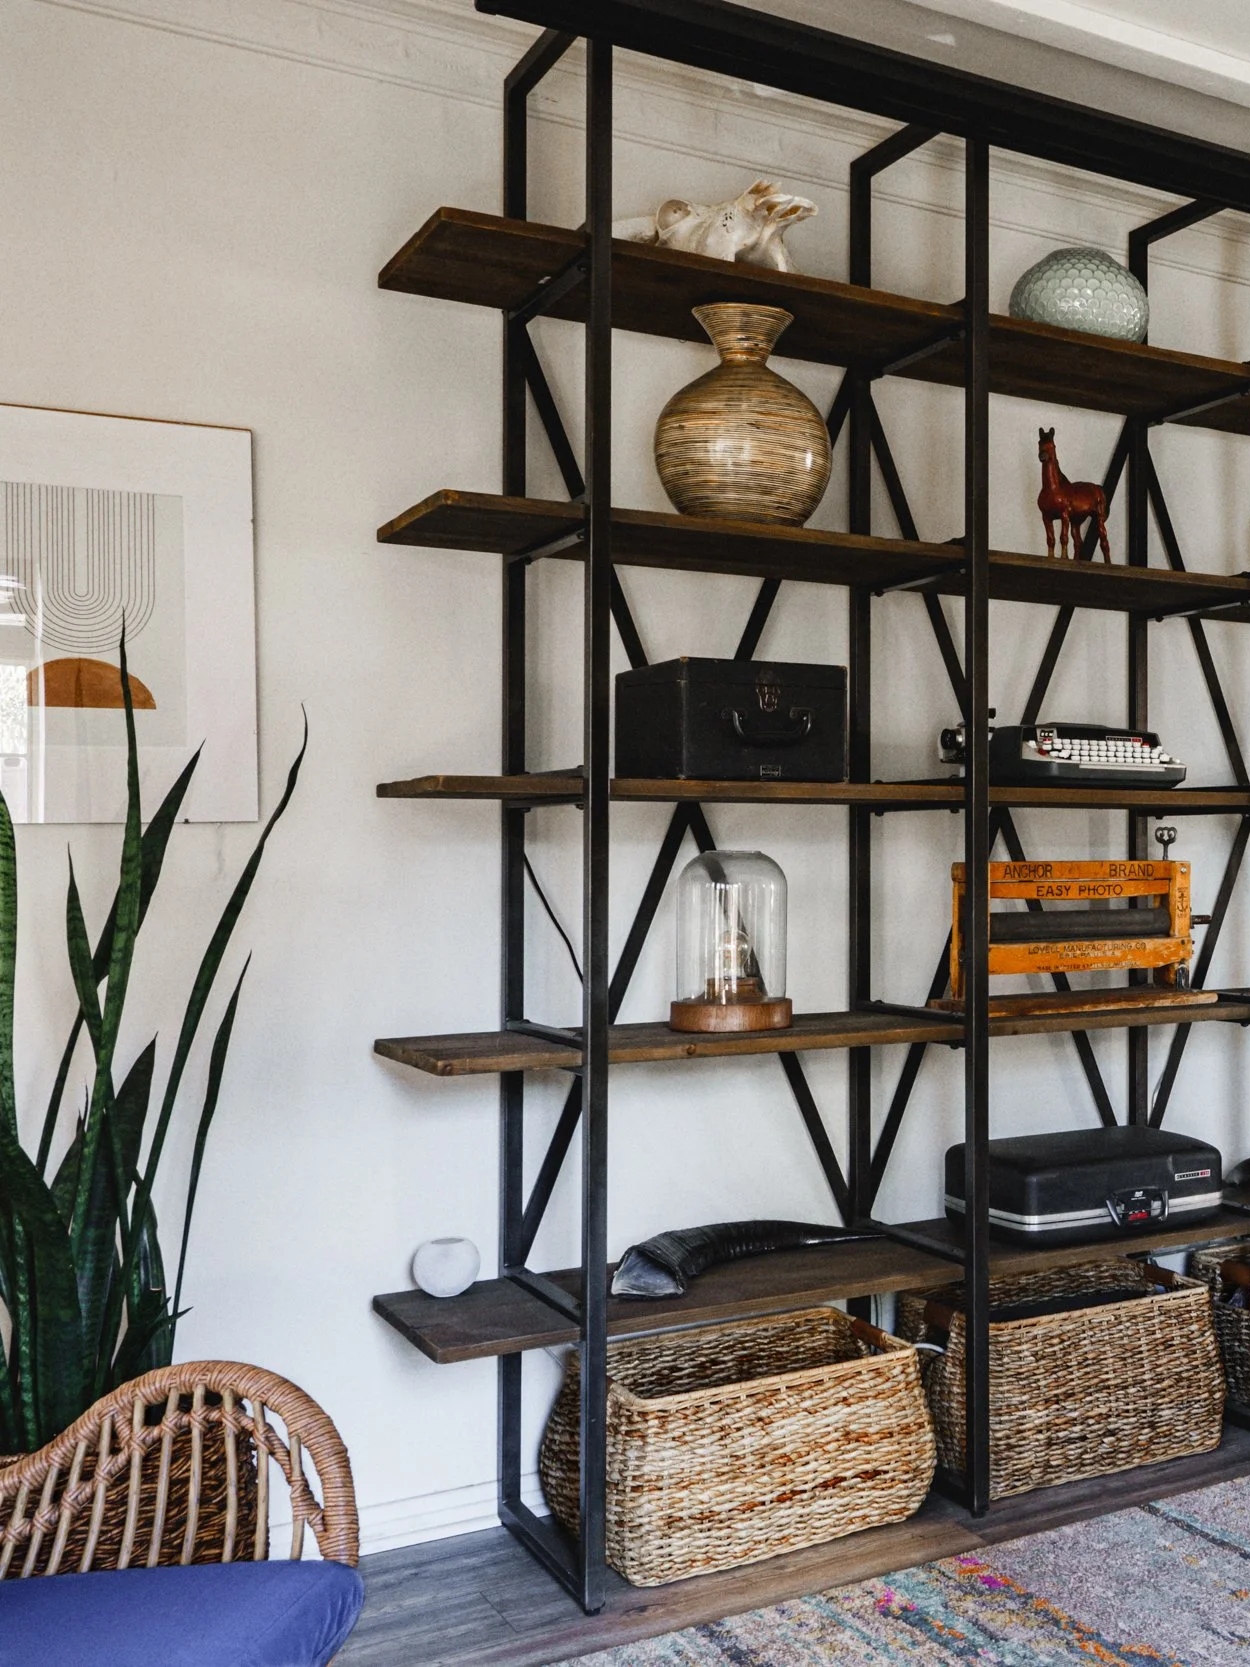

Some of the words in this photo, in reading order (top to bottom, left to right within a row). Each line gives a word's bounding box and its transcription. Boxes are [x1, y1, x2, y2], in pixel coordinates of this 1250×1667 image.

[1003, 863, 1053, 879] ANCHOR
[1108, 863, 1155, 877] BRAND
[1036, 885, 1071, 897] EASY
[1078, 884, 1123, 896] PHOTO
[1063, 942, 1133, 953] MANUFACTURING
